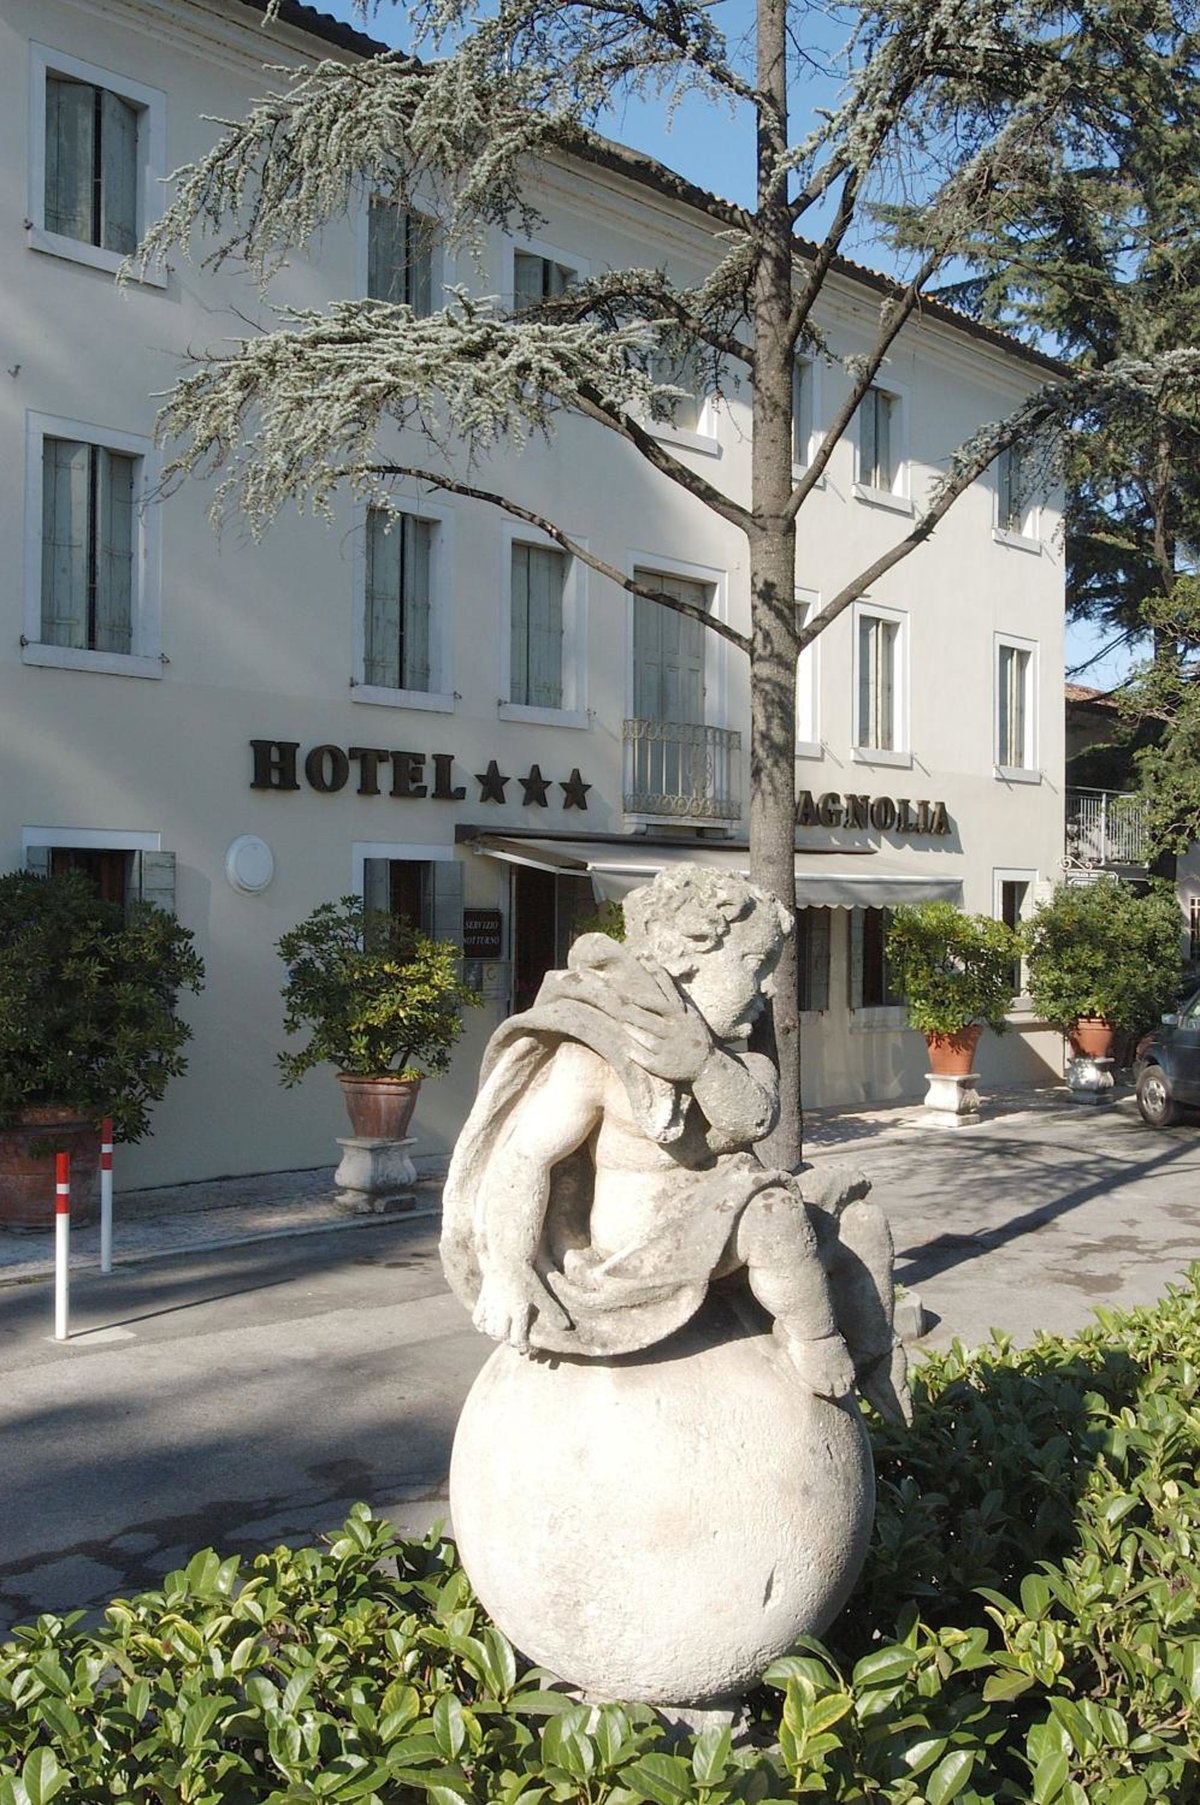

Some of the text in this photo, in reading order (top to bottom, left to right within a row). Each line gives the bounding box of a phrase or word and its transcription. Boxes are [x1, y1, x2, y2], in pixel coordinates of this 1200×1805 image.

[250, 739, 466, 800] HOTEL
[795, 790, 952, 835] AGNOLIA
[464, 920, 499, 930] SERVIZIO
